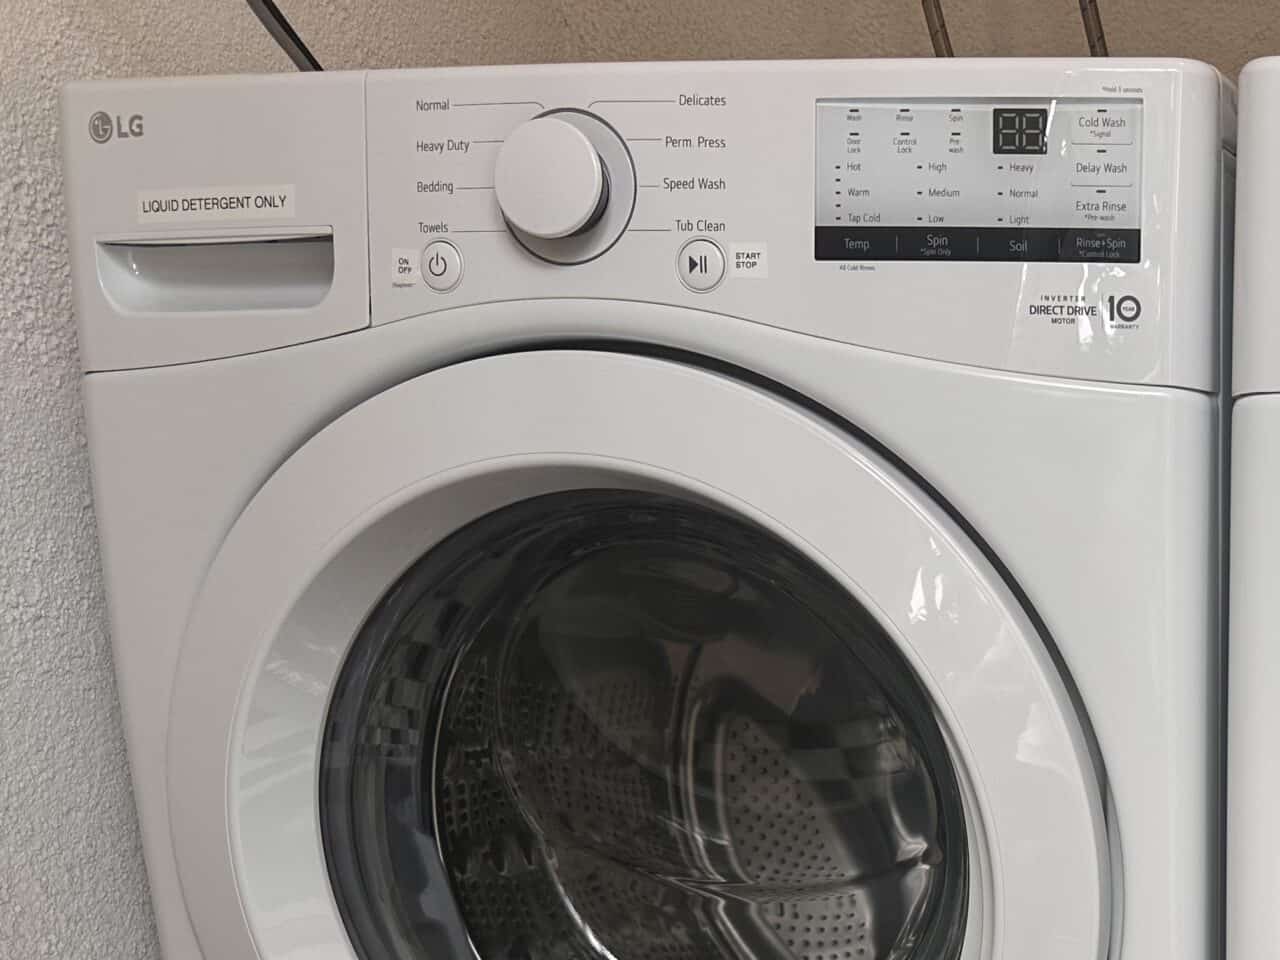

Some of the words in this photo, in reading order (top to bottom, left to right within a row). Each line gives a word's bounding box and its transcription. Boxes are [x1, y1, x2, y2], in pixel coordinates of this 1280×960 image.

[416, 100, 449, 112] Normal
[679, 94, 726, 106] Delicates
[117, 115, 144, 138] LG
[1078, 116, 1099, 128] Cold
[1101, 116, 1126, 128] Wash
[417, 140, 445, 153] Heavy
[447, 141, 470, 153] Duty
[698, 136, 726, 148] Press
[893, 137, 917, 145] Control
[847, 162, 861, 171] Hot
[928, 162, 947, 174] High
[1009, 163, 1034, 175] Heavy
[1076, 163, 1100, 175] Delay
[1104, 163, 1127, 174] Wash
[417, 181, 454, 194] Bedding
[663, 178, 695, 192] Speed
[698, 178, 726, 190] Wash
[848, 188, 870, 197] Warm
[928, 188, 960, 197] Medium
[1009, 188, 1038, 198] Normal
[142, 200, 179, 213] LIQUID
[181, 197, 252, 212] DETERGENT
[255, 196, 286, 209] ONLY
[1076, 201, 1100, 212] Extra
[1102, 201, 1127, 212] Rinse
[848, 213, 861, 224] Tap
[863, 213, 881, 223] Cold
[928, 214, 944, 223] Low
[1009, 215, 1029, 226] Light
[418, 222, 448, 233] Towels
[675, 220, 694, 232] Tub
[696, 220, 725, 232] Clean
[927, 234, 949, 247] Spin
[1008, 240, 1028, 252] Soil
[398, 257, 409, 265] ON
[736, 252, 760, 260] START
[398, 266, 412, 274] OFF
[736, 261, 757, 269] STOP
[1029, 304, 1064, 315] DIRECT
[1066, 305, 1097, 316] DRIVE
[1108, 295, 1141, 322] 10
